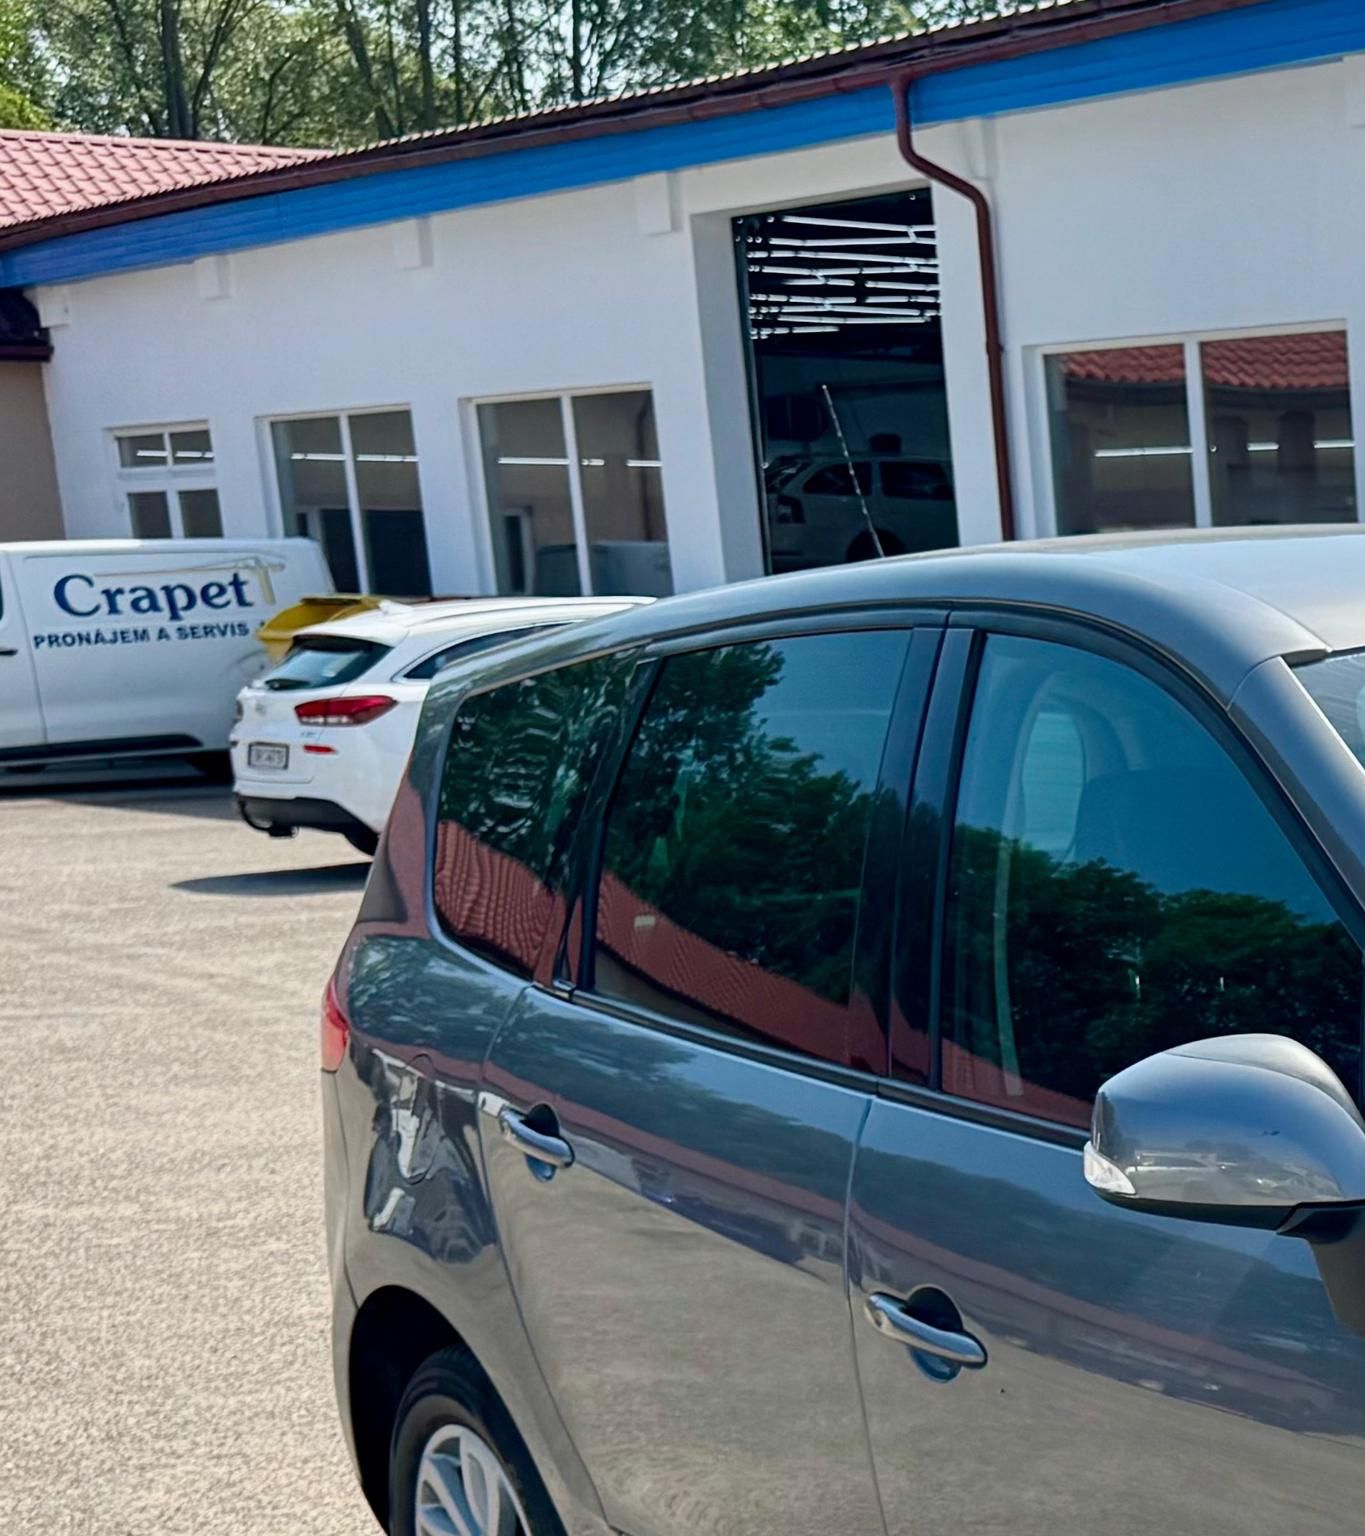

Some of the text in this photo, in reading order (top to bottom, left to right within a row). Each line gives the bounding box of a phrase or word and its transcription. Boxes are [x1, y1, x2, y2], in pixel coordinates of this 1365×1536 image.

[53, 573, 255, 621] Crapet
[156, 626, 171, 642] A
[176, 621, 250, 641] SERVIS
